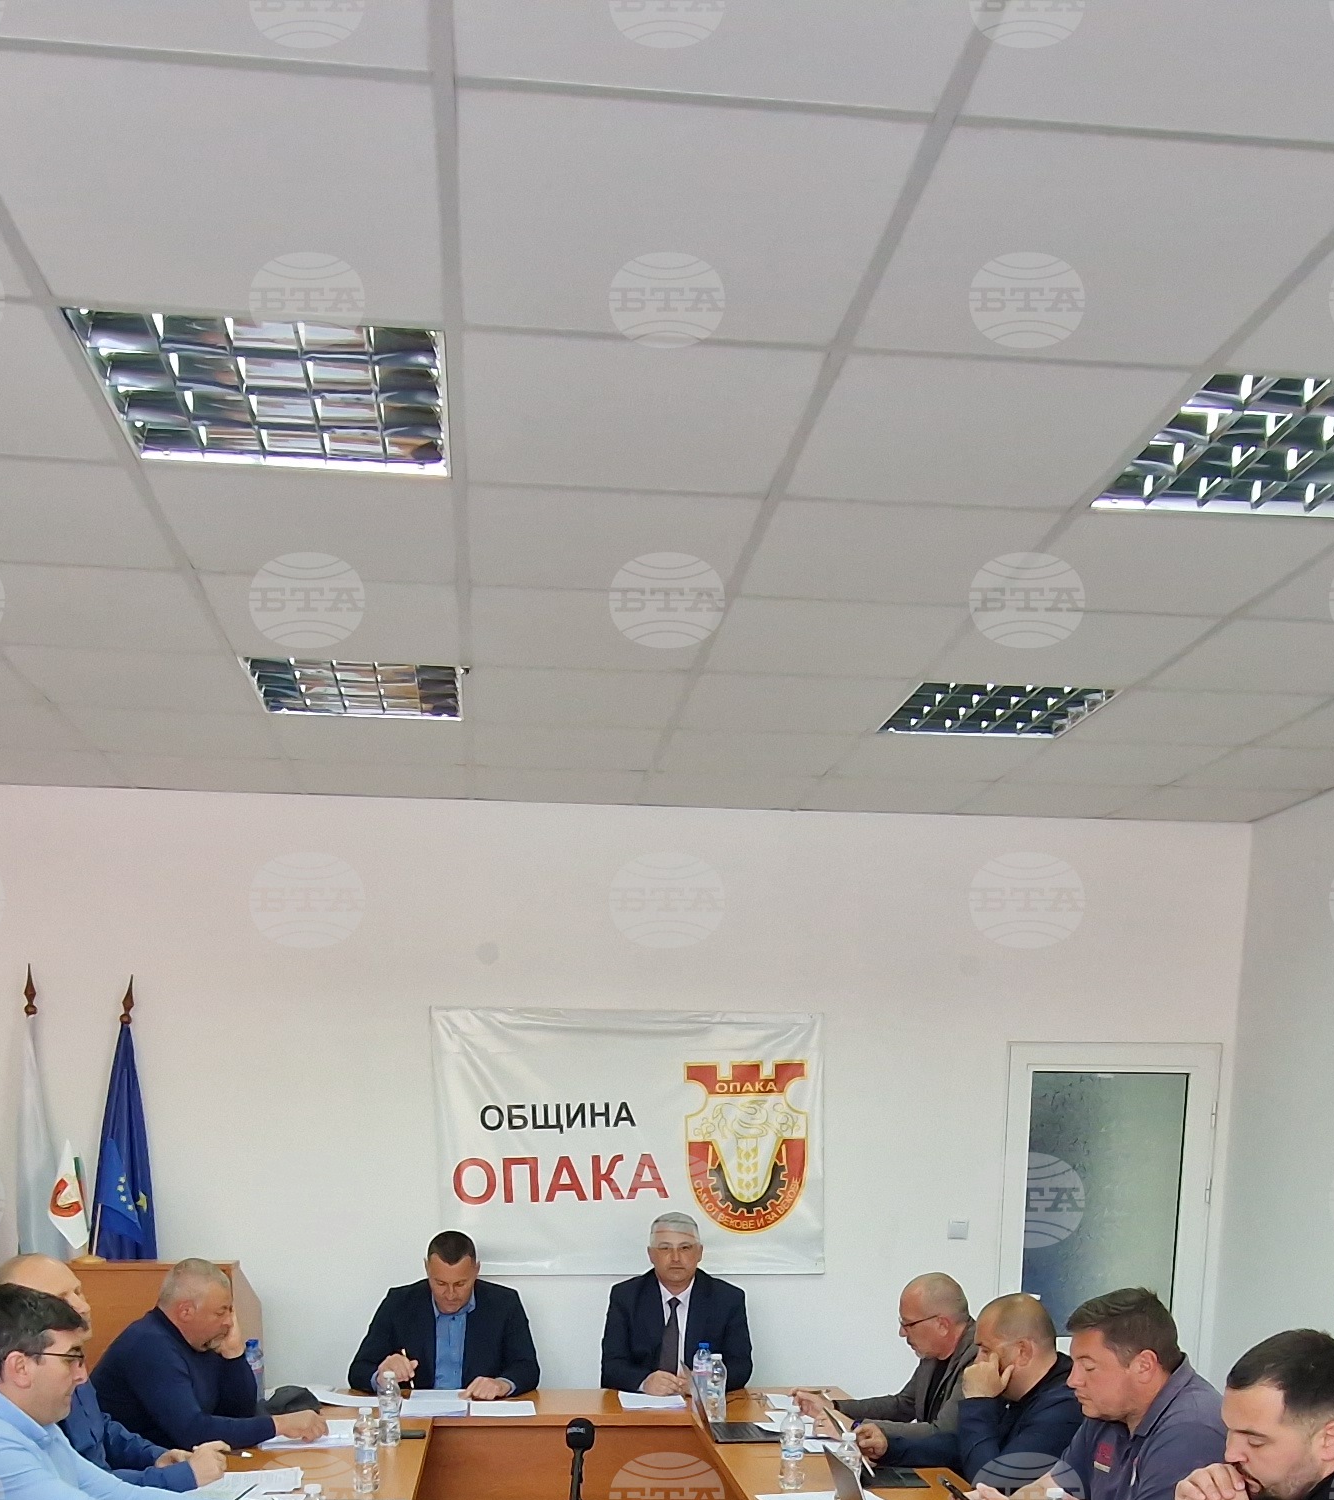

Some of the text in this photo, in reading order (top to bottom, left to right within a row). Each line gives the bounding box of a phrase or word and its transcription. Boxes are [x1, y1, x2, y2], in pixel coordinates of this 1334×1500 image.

[715, 1081, 778, 1094] ОПАКА
[479, 1101, 637, 1134] ОБЩИНА
[451, 1153, 670, 1206] ОПАКА
[756, 1218, 765, 1228] И
[765, 1212, 779, 1224] ЗА
